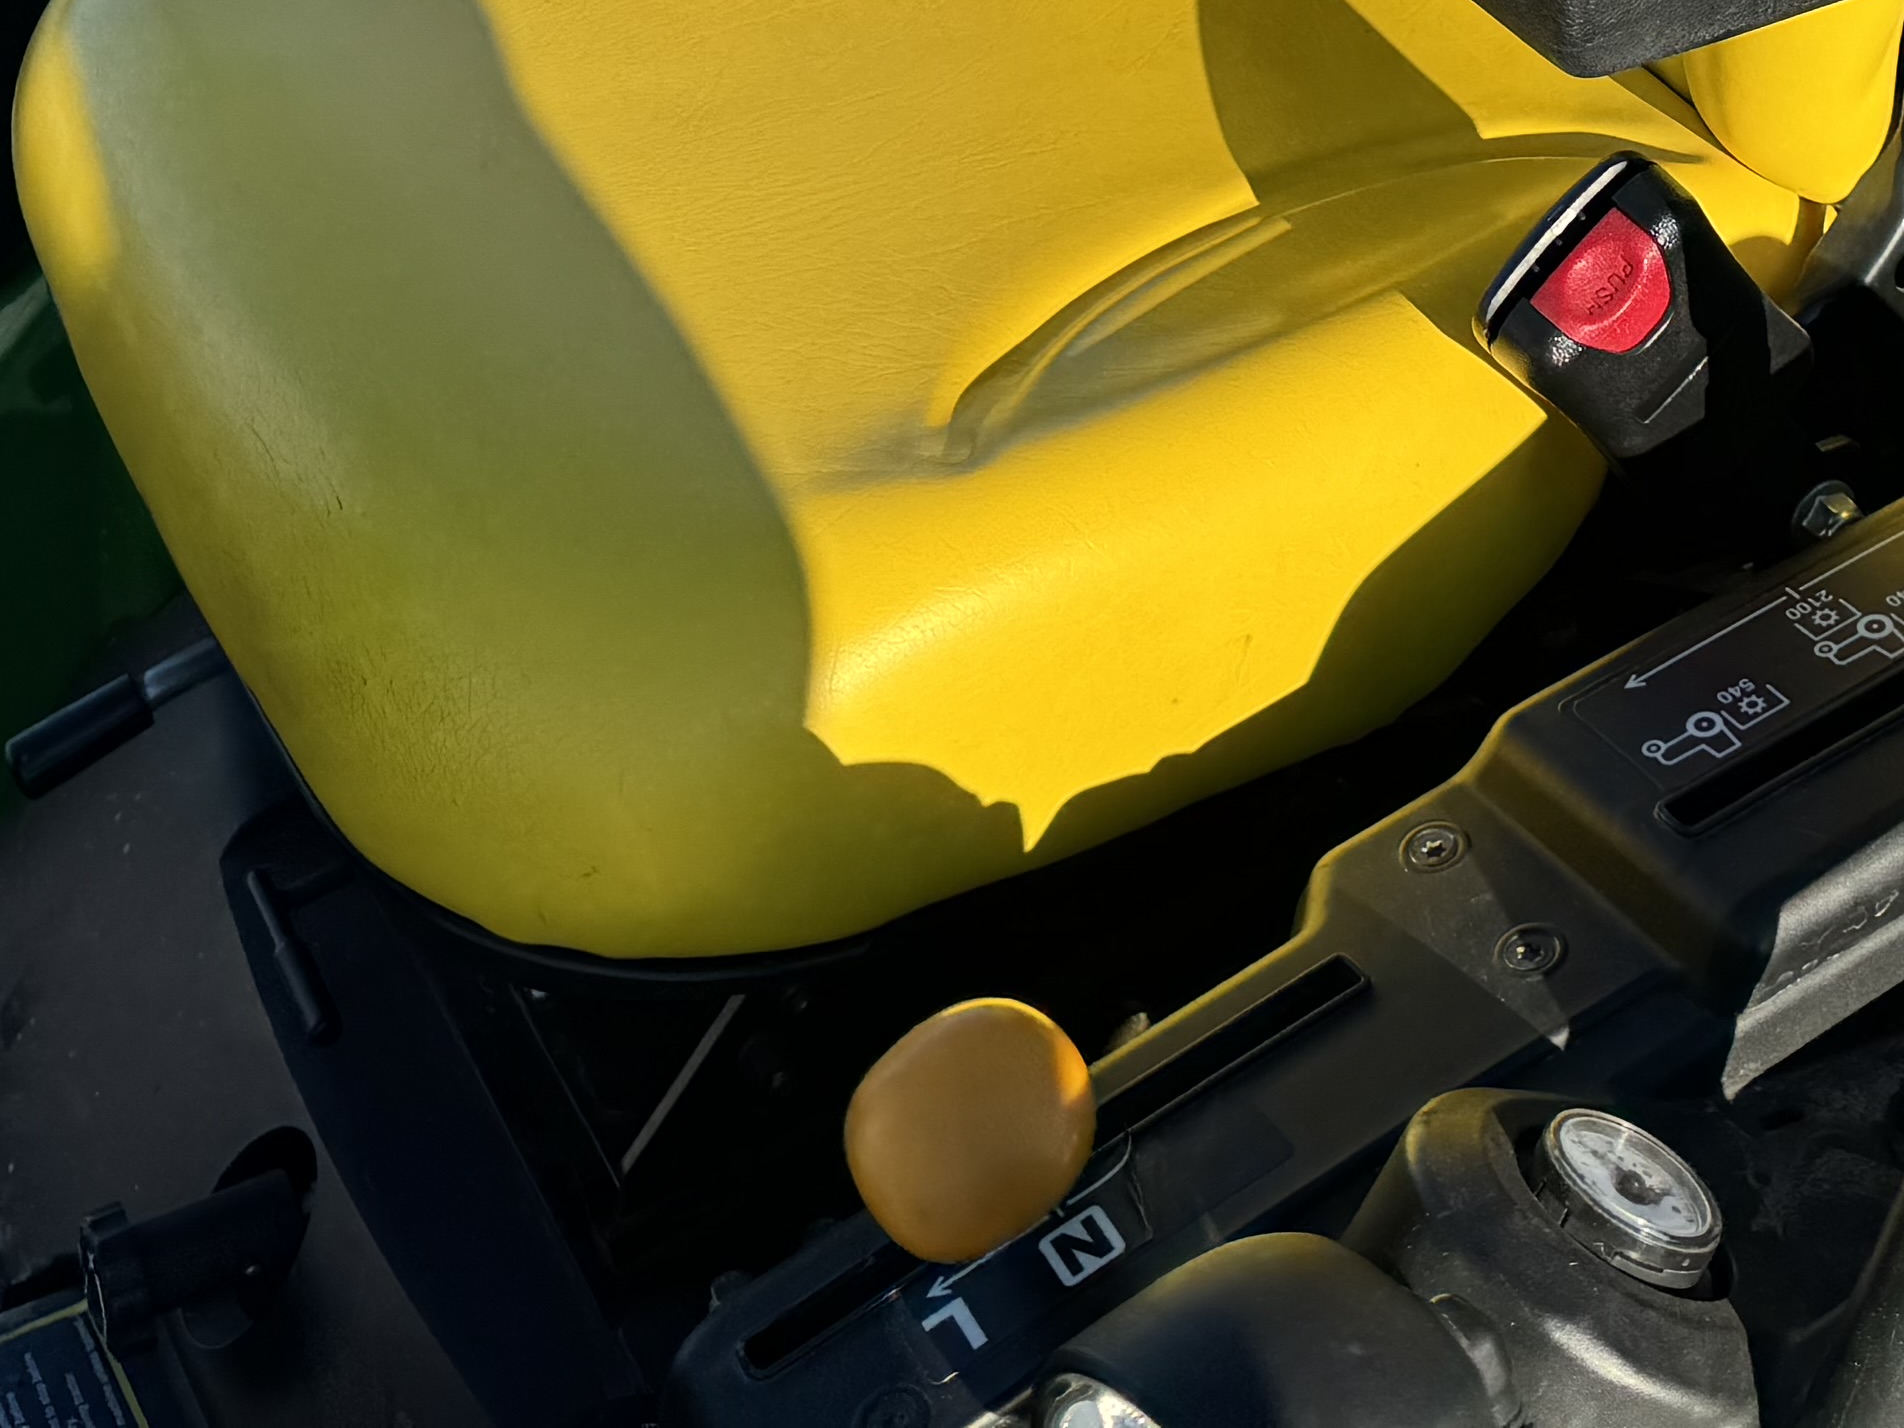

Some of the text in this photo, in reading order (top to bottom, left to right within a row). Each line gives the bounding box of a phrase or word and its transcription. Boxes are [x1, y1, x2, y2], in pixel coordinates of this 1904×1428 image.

[1584, 252, 1635, 318] PUSH
[1784, 589, 1834, 621] 2100
[1716, 677, 1756, 705] 540
[1049, 1214, 1116, 1277] N
[921, 1296, 989, 1351] L
